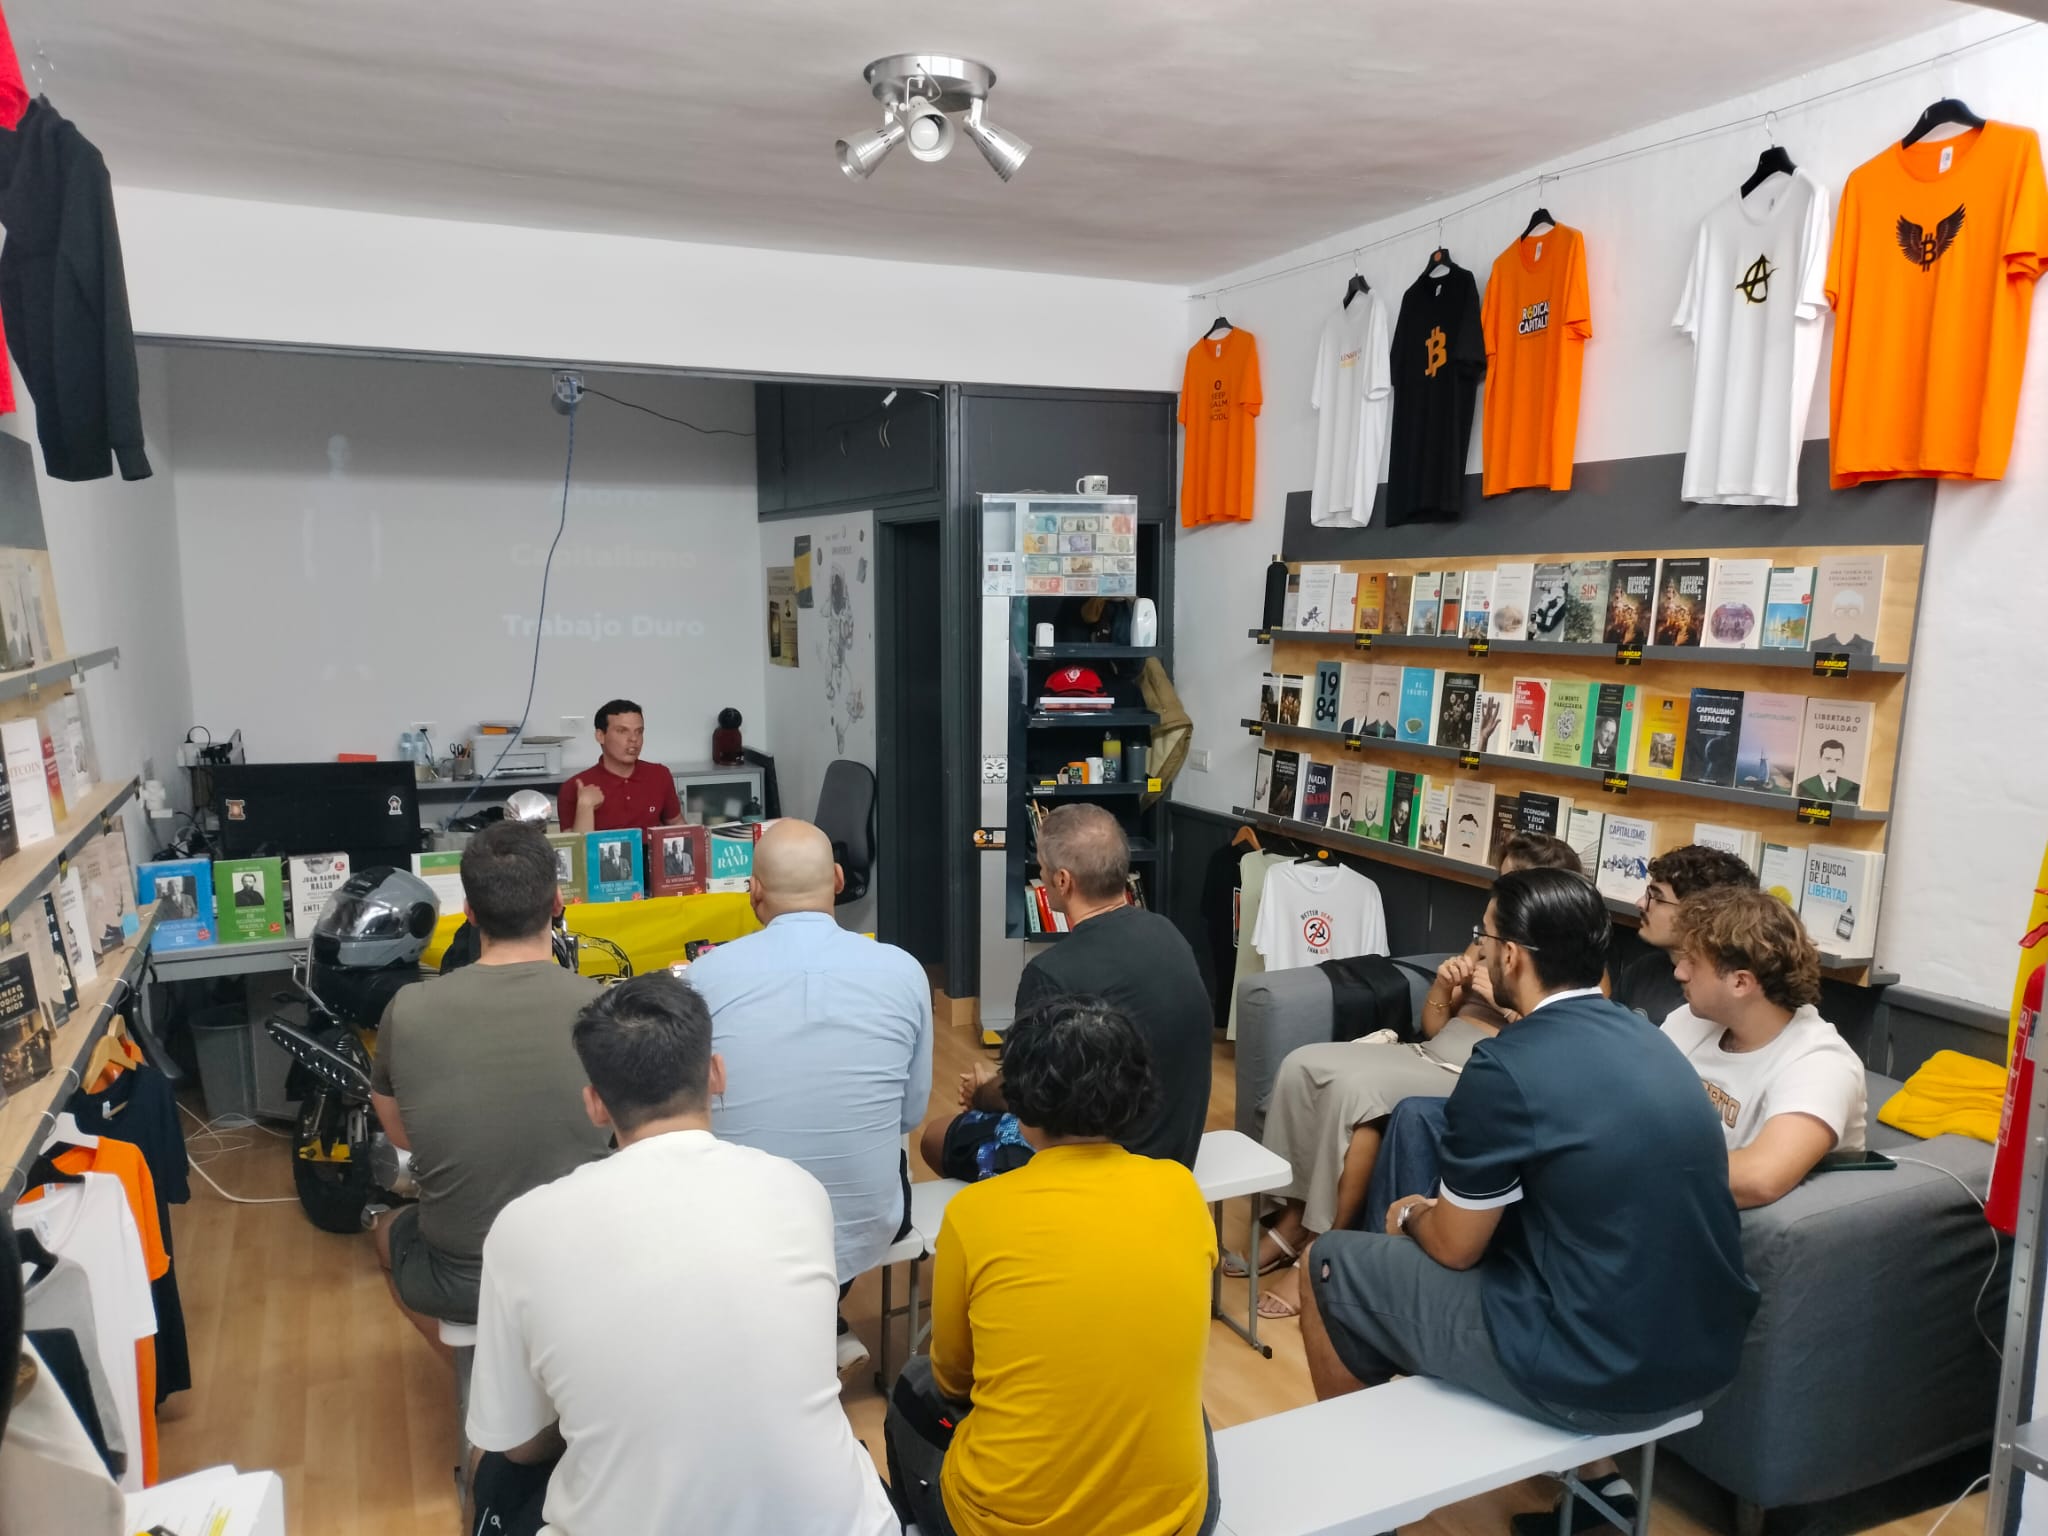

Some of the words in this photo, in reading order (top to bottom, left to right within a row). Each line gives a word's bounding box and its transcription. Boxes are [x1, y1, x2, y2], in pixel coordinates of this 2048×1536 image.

[1582, 584, 1598, 594] SIN
[502, 612, 622, 642] Trabajo
[632, 615, 705, 636] Duro
[1320, 672, 1338, 696] 19
[1315, 697, 1336, 722] 84
[1696, 706, 1736, 716] CAPITALISMO
[1699, 715, 1730, 724] ESPACIAL
[1814, 713, 1850, 723] LIBERTAD
[1815, 724, 1858, 733] IGUALDAD
[1308, 774, 1326, 786] NADA
[1307, 784, 1316, 793] ES
[724, 845, 742, 857] AYN
[718, 854, 748, 868] RAND
[1810, 860, 1820, 872] EN
[1822, 862, 1847, 877] BUSCA
[1809, 871, 1819, 883] DE
[1821, 874, 1830, 886] LA
[311, 881, 332, 890] RALLO
[1808, 883, 1847, 902] LIBERTAD
[0, 984, 22, 1000] NERO
[6, 1001, 23, 1013] DIOS
